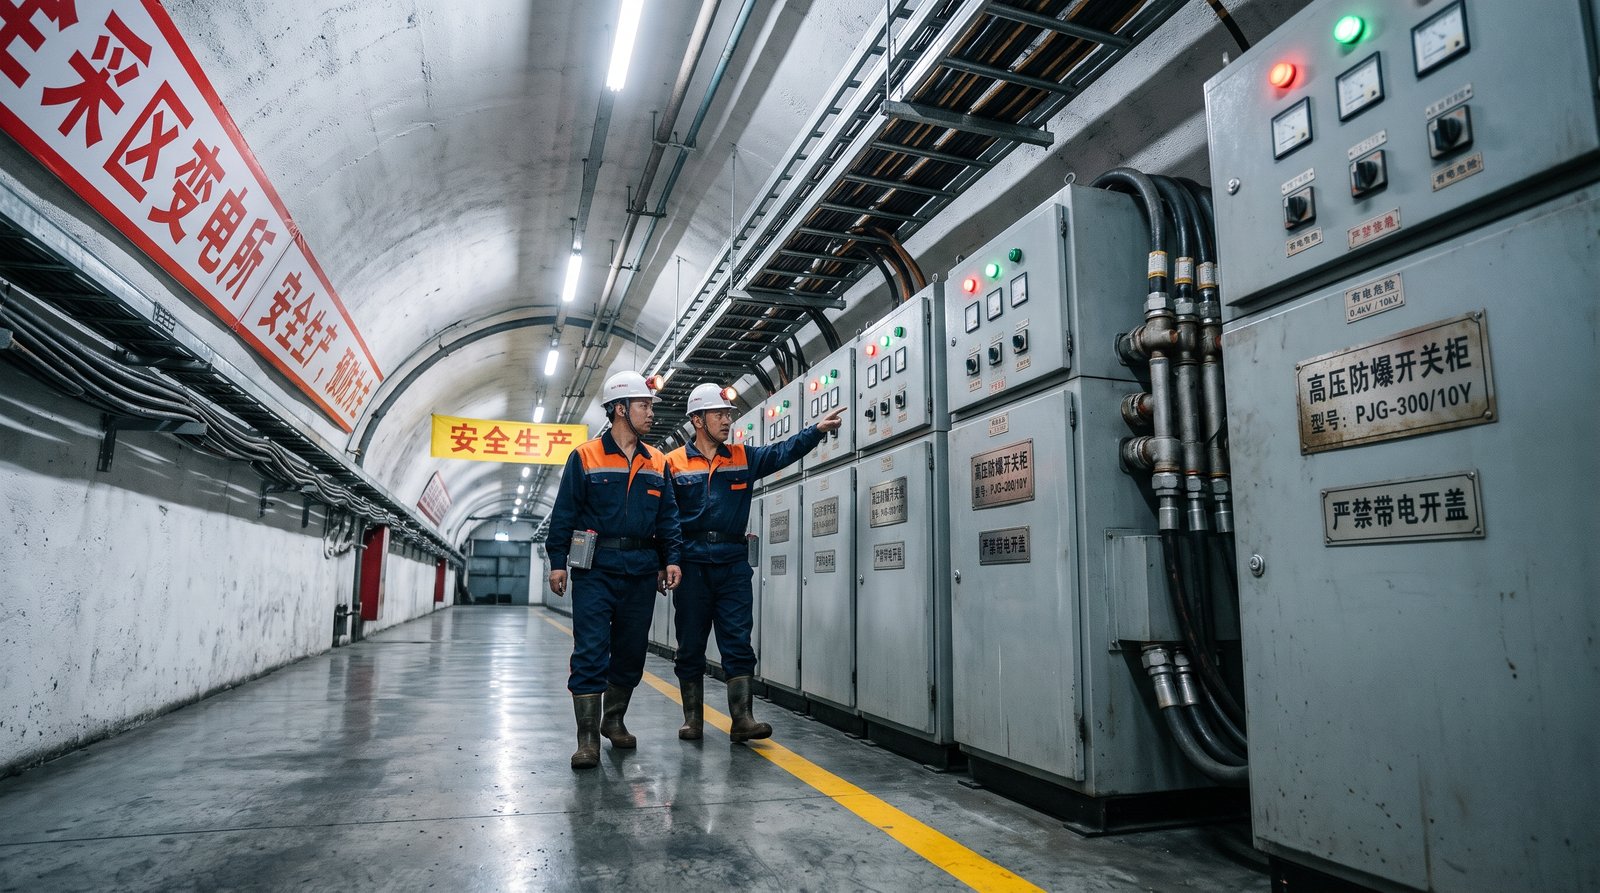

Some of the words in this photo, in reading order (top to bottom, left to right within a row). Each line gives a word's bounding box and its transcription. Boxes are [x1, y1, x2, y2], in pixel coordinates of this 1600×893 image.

[1350, 303, 1371, 317] 0.4kV
[1379, 293, 1399, 307] 10kV
[1351, 279, 1395, 303] 有电危险
[1307, 335, 1472, 405] 高压防爆开关柜
[1356, 382, 1473, 424] PJG-300/10Y
[450, 423, 573, 458] 安全生产
[1332, 487, 1469, 531] 严禁带电开盖
